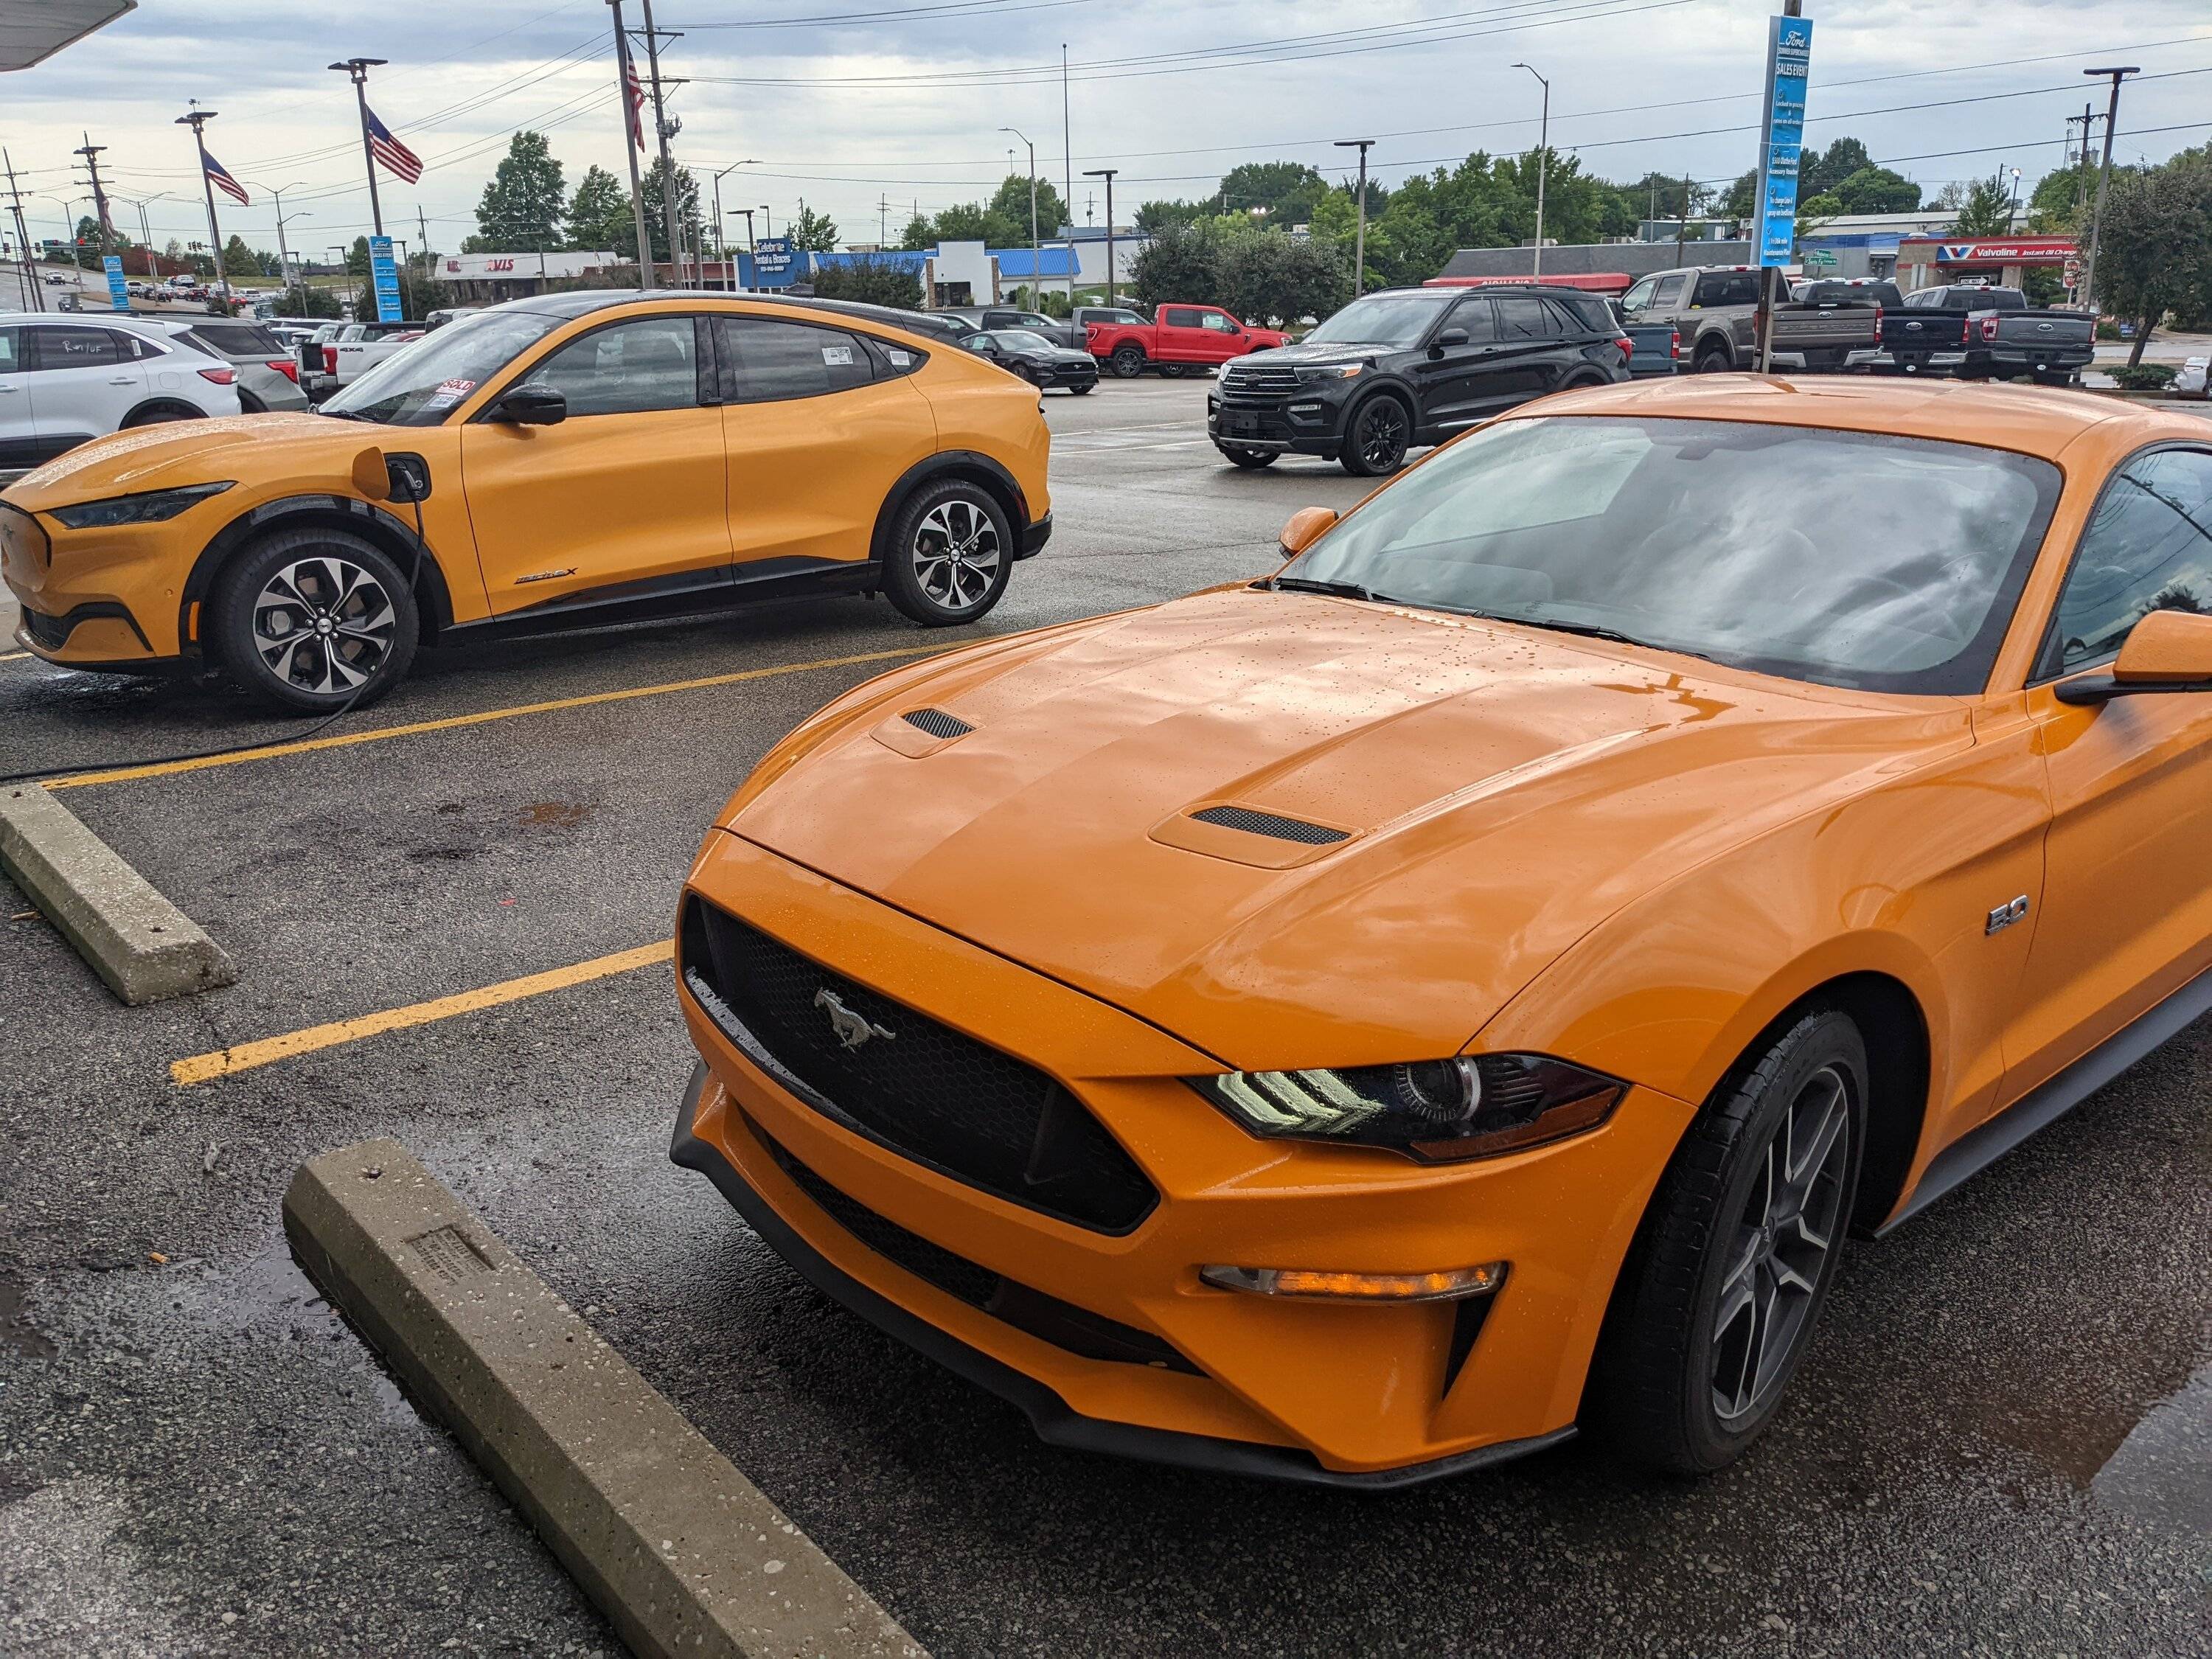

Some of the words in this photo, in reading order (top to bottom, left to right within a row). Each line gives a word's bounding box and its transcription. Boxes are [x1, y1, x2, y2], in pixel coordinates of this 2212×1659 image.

[1785, 30, 1806, 47] Ford
[1776, 63, 1792, 75] SALES
[1792, 64, 1808, 77] EVENT
[773, 254, 791, 264] Braces
[1976, 248, 2018, 257] Valvoline
[484, 259, 515, 272] AVIS
[442, 379, 473, 390] SOLD
[1985, 894, 2029, 936] 5.0
